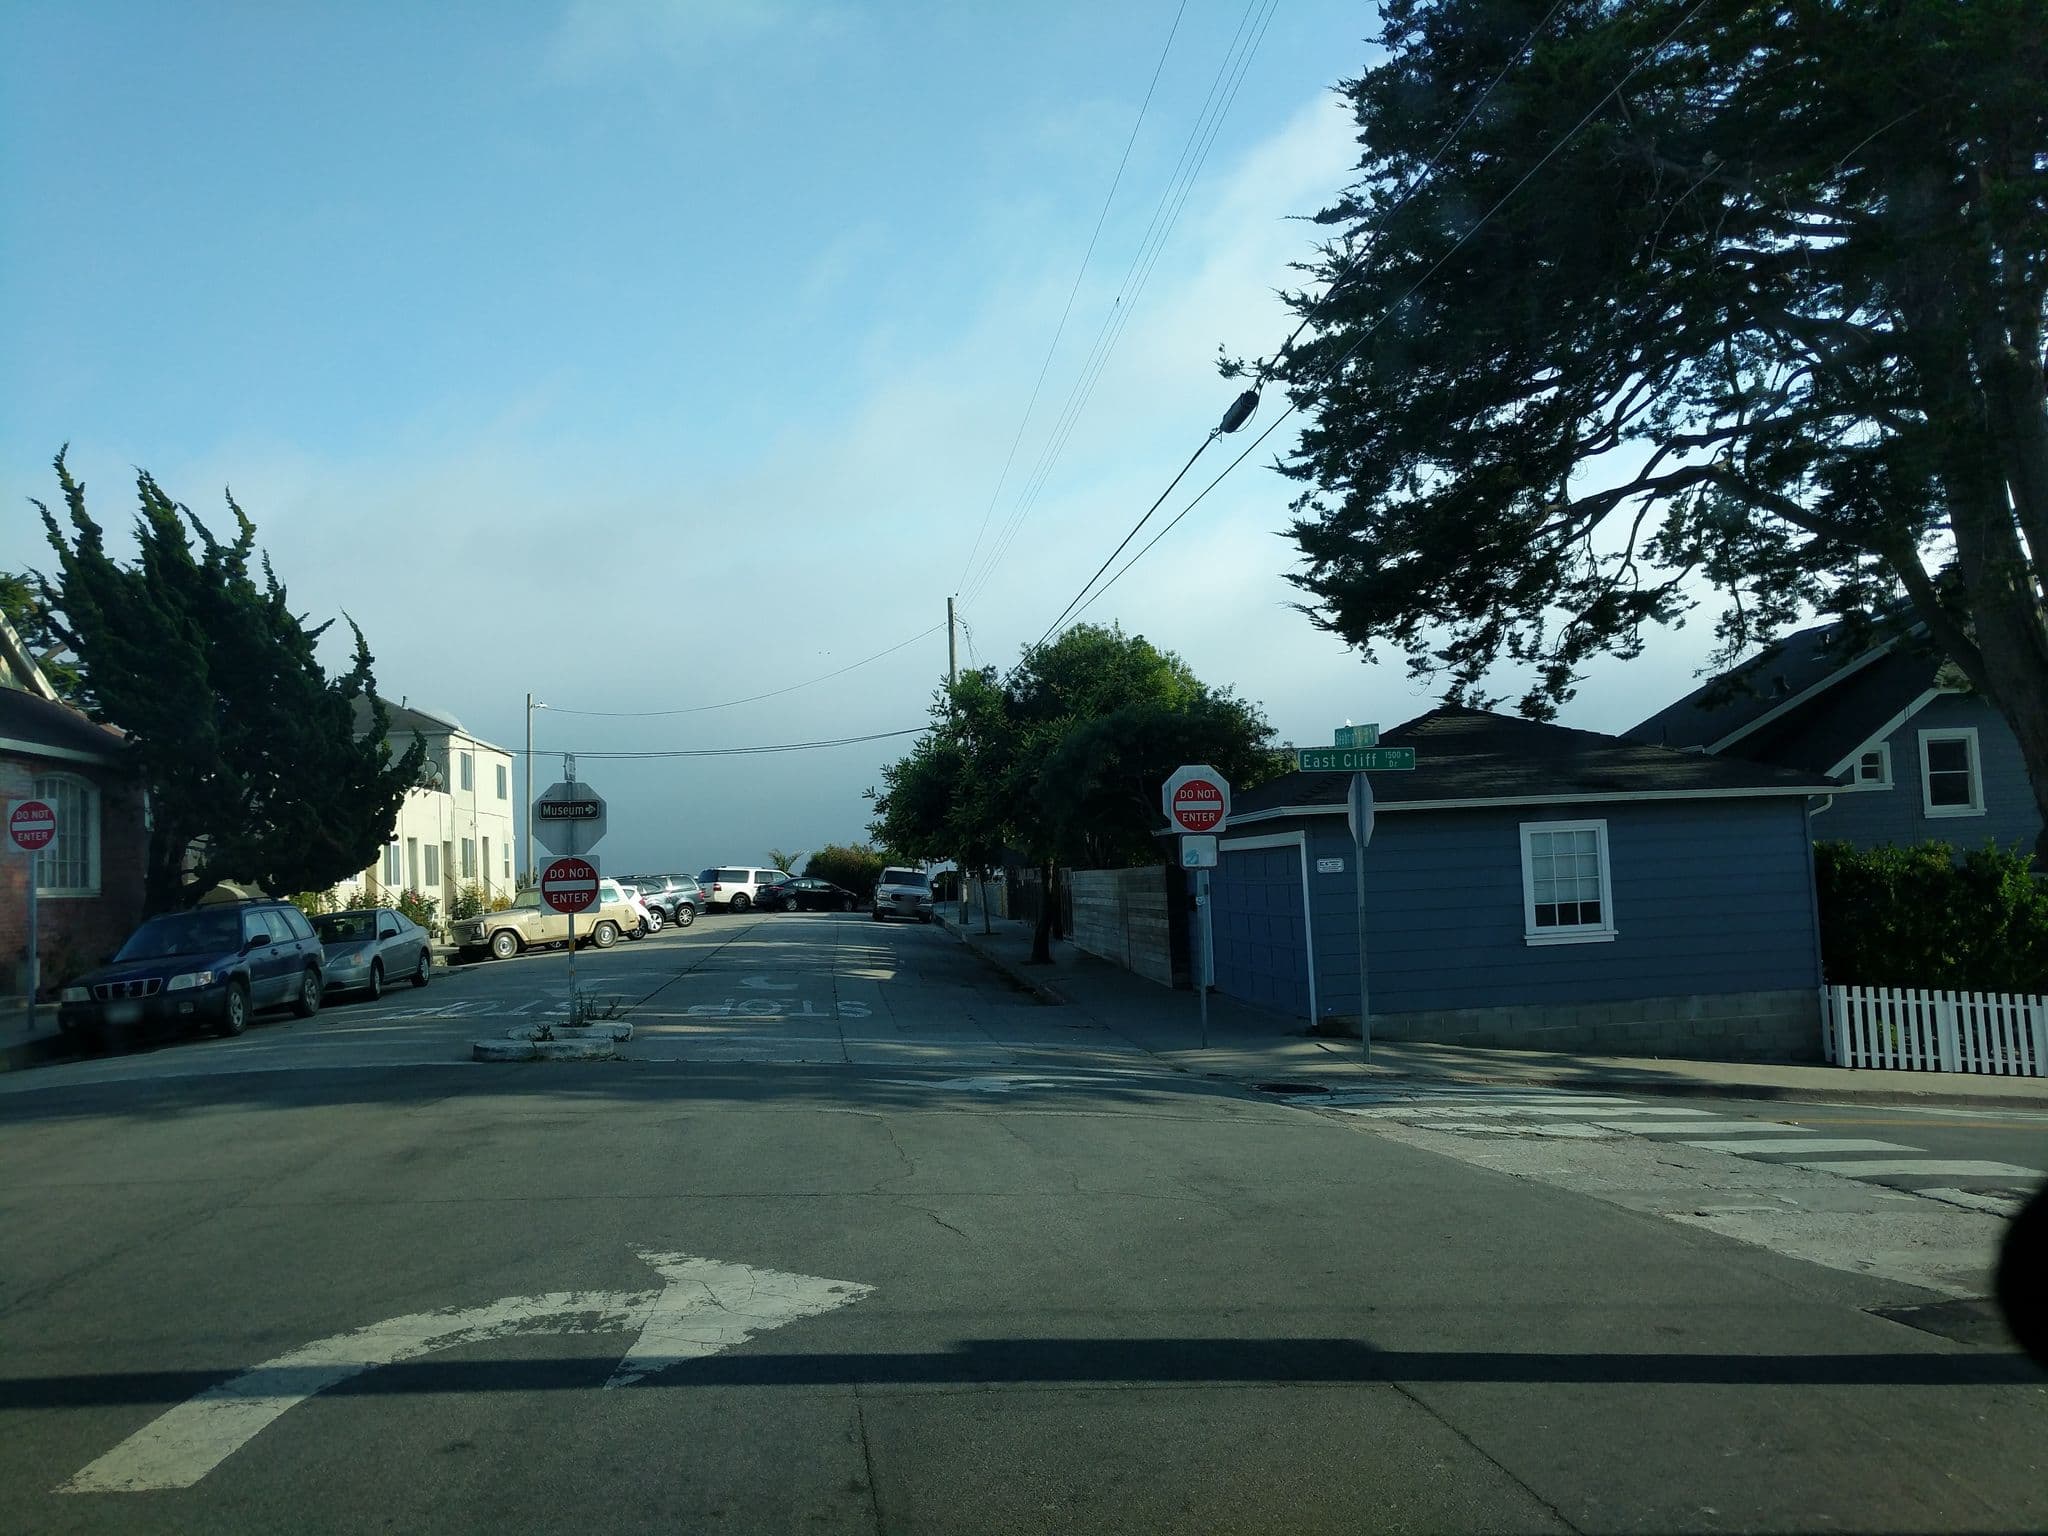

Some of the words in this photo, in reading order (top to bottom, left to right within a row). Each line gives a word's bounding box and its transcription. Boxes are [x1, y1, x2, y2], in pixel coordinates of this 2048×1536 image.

[1303, 753, 1336, 768] East
[1343, 752, 1377, 768] Cliff
[1384, 751, 1401, 760] 1500
[1180, 789, 1194, 799] DO
[1197, 789, 1216, 799] NOT
[16, 810, 29, 820] DO
[31, 809, 49, 819] NOT
[542, 804, 584, 816] Museum
[1182, 812, 1215, 822] ENTER
[18, 831, 48, 842] ENTER
[550, 868, 565, 879] DO
[569, 867, 590, 878] NOT
[552, 892, 589, 904] ENTER
